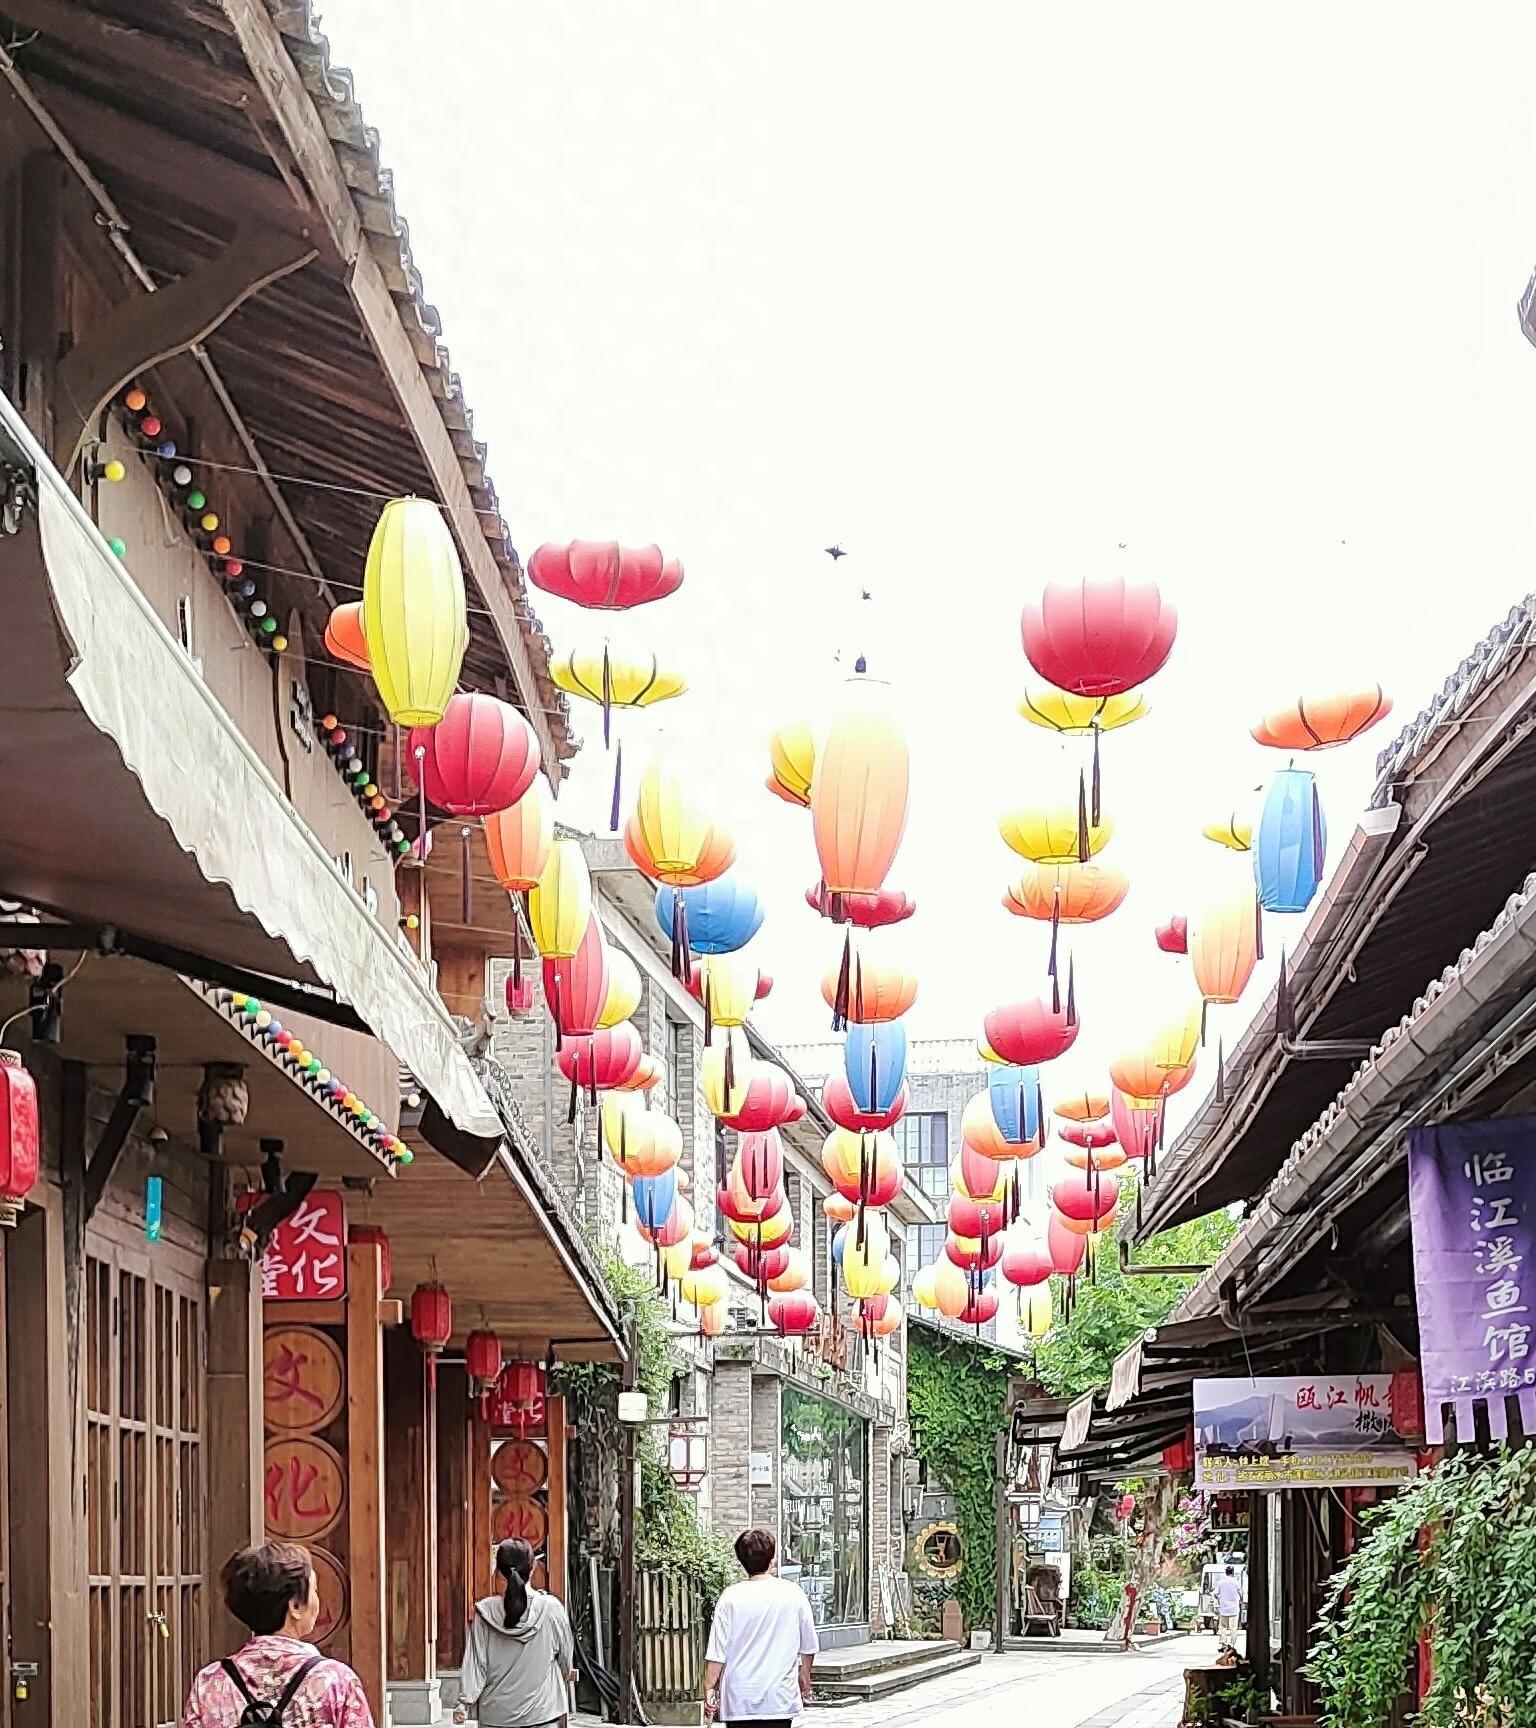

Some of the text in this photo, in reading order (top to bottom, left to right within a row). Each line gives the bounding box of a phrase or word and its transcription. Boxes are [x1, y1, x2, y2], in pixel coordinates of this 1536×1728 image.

[1464, 1152, 1528, 1362] 临江溪鱼馆
